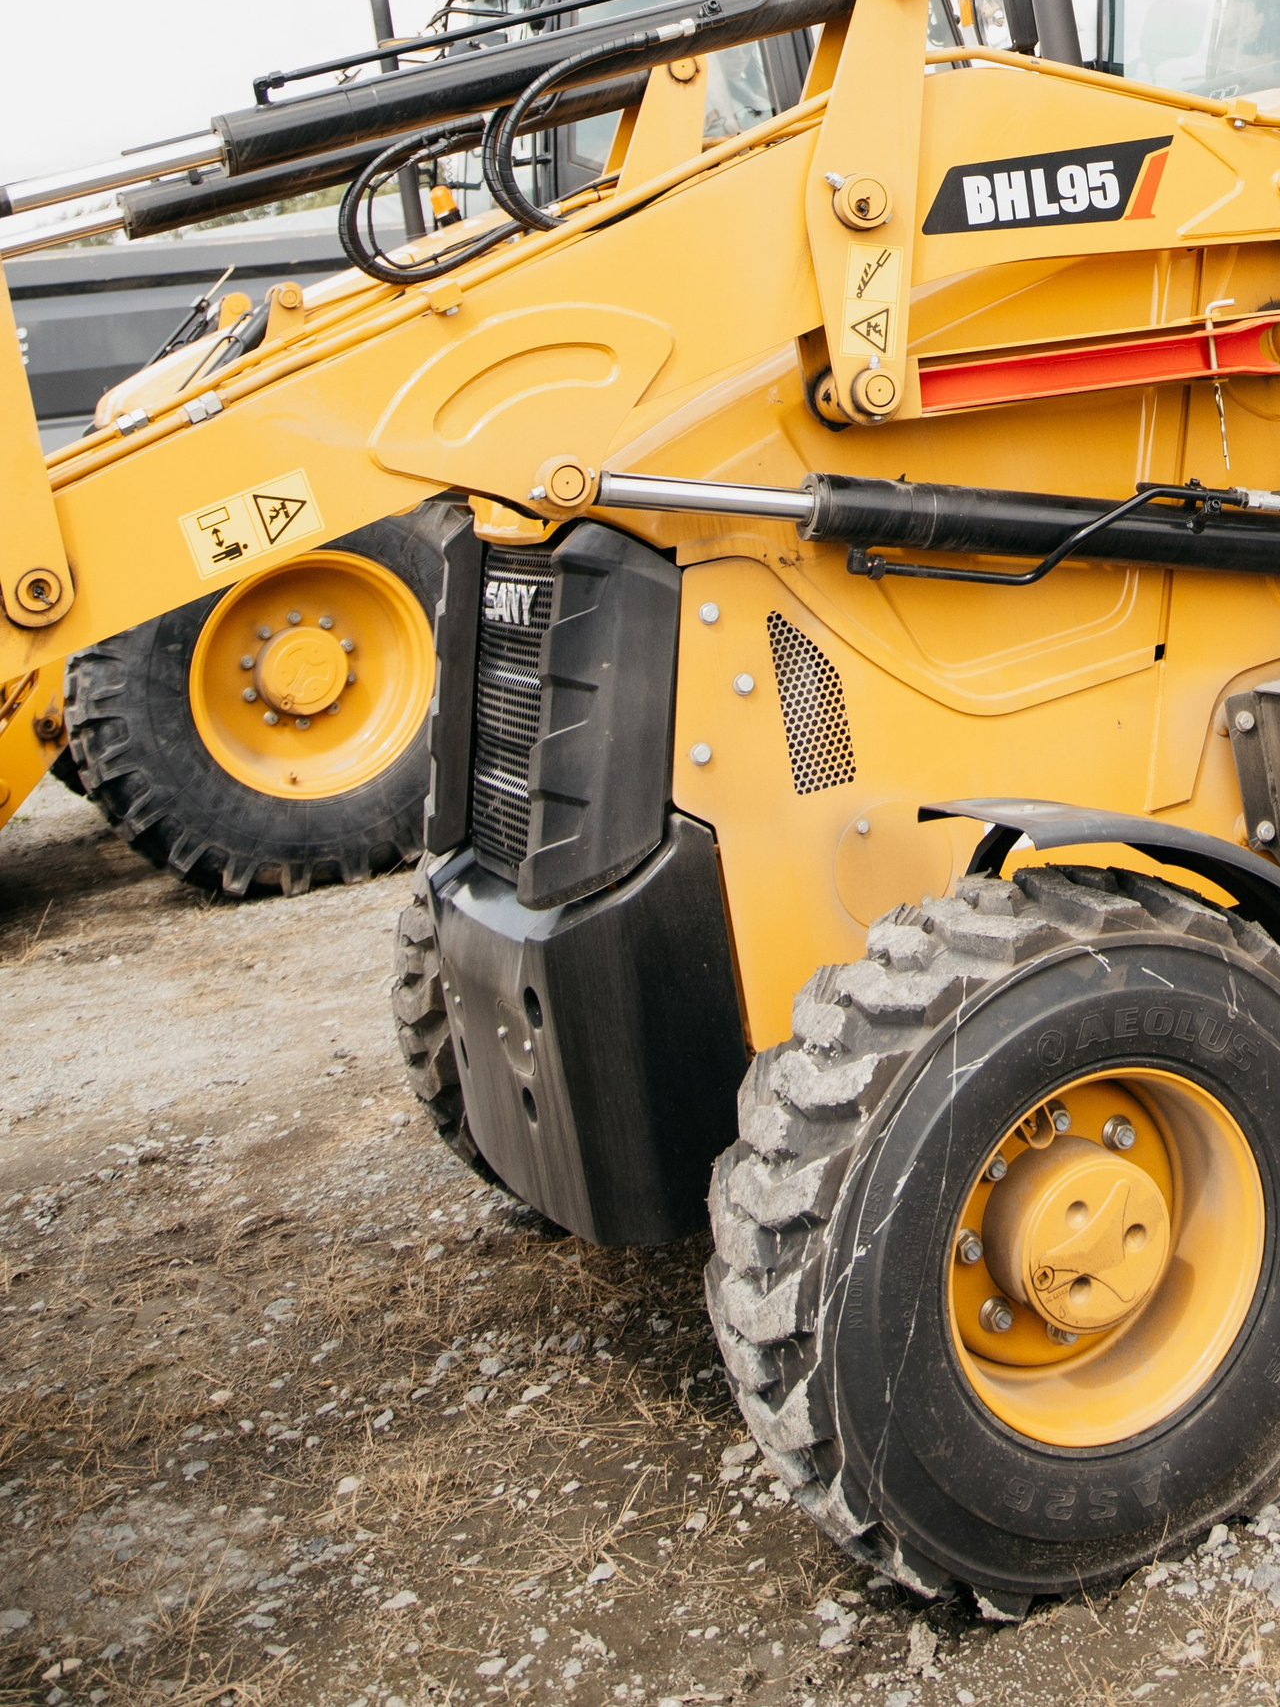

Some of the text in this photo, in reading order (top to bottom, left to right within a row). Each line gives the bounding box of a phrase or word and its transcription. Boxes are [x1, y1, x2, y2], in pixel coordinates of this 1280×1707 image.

[961, 160, 1122, 226] BHL95
[484, 581, 539, 626] SANY
[1075, 1006, 1260, 1072] AEOLUS
[847, 1180, 886, 1331] NYLON TBELESS
[1002, 1465, 1164, 1522] AS26
